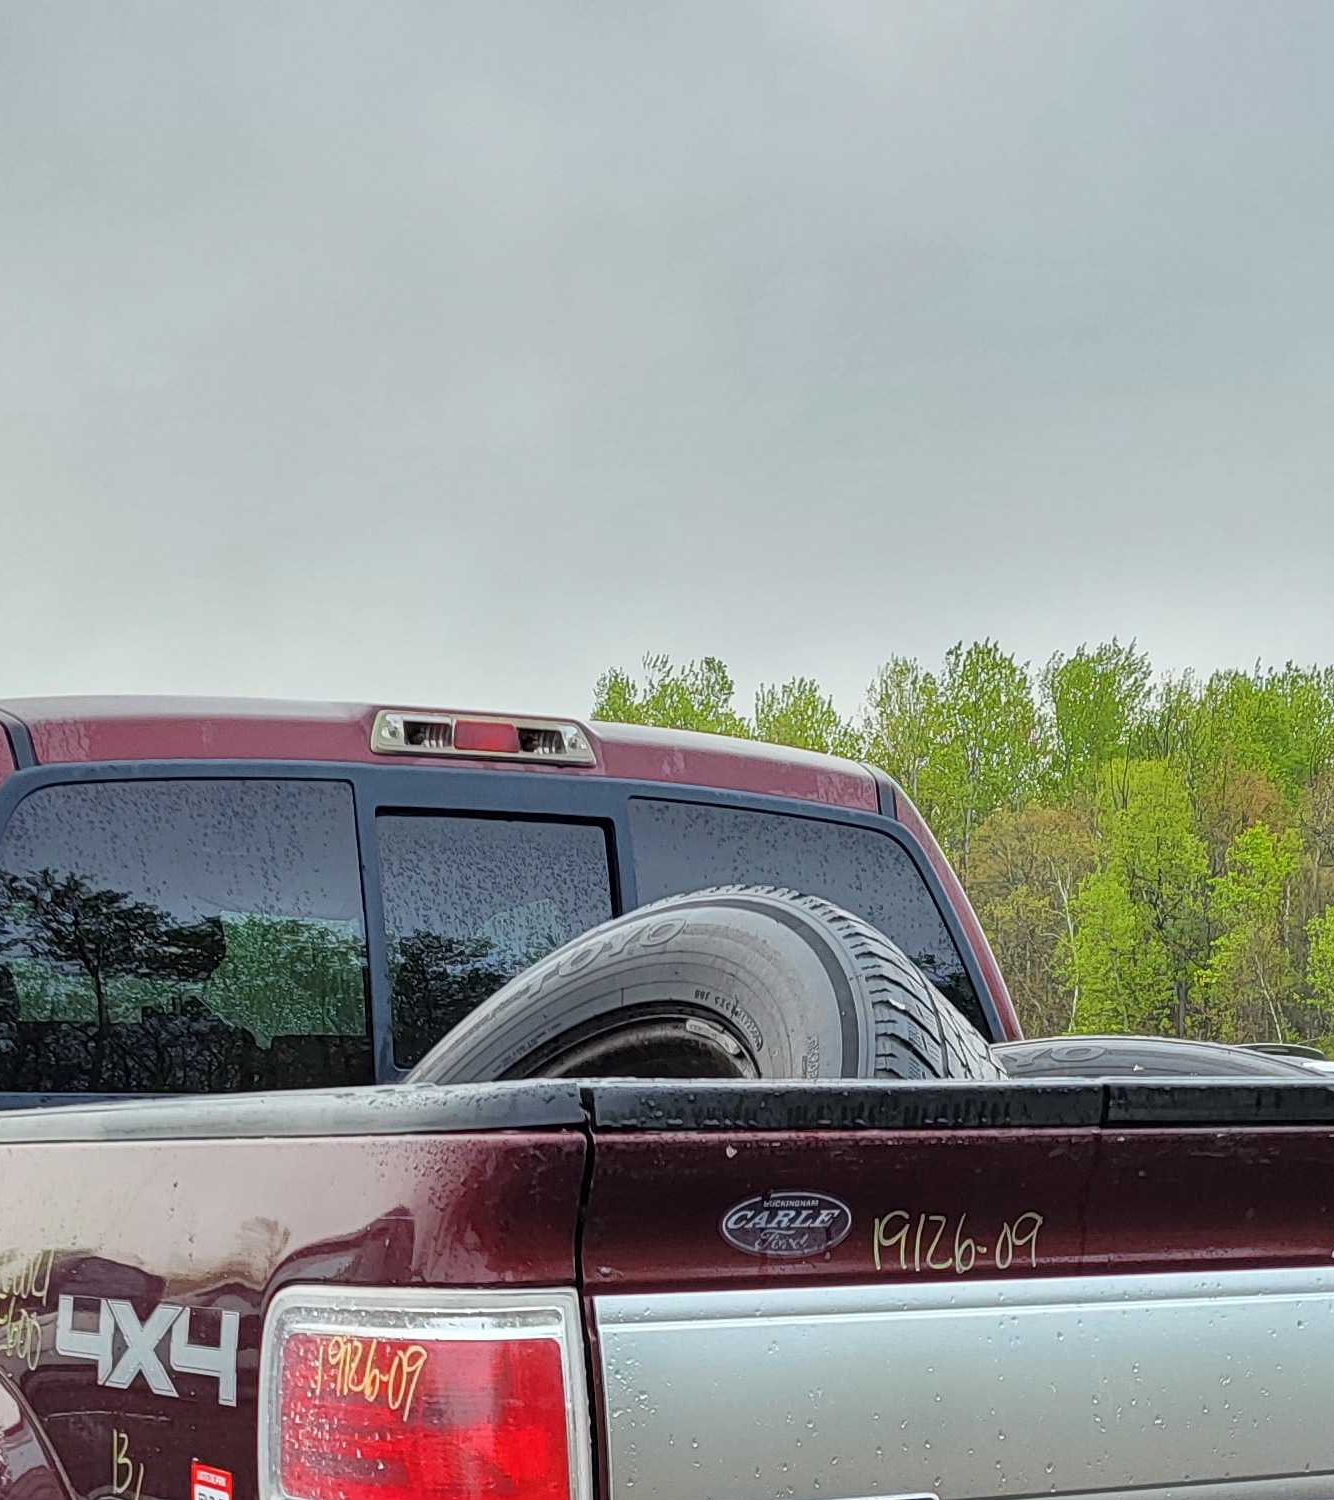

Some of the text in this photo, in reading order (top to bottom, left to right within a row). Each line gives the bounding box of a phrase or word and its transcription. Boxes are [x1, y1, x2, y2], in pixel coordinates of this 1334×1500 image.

[517, 917, 688, 1000] TOYO
[1002, 1046, 1107, 1068] YO
[727, 1209, 841, 1229] CARLE
[873, 1210, 1044, 1274] 19126-09
[56, 1294, 240, 1407] 4X4
[315, 1335, 427, 1422] 19126-09
